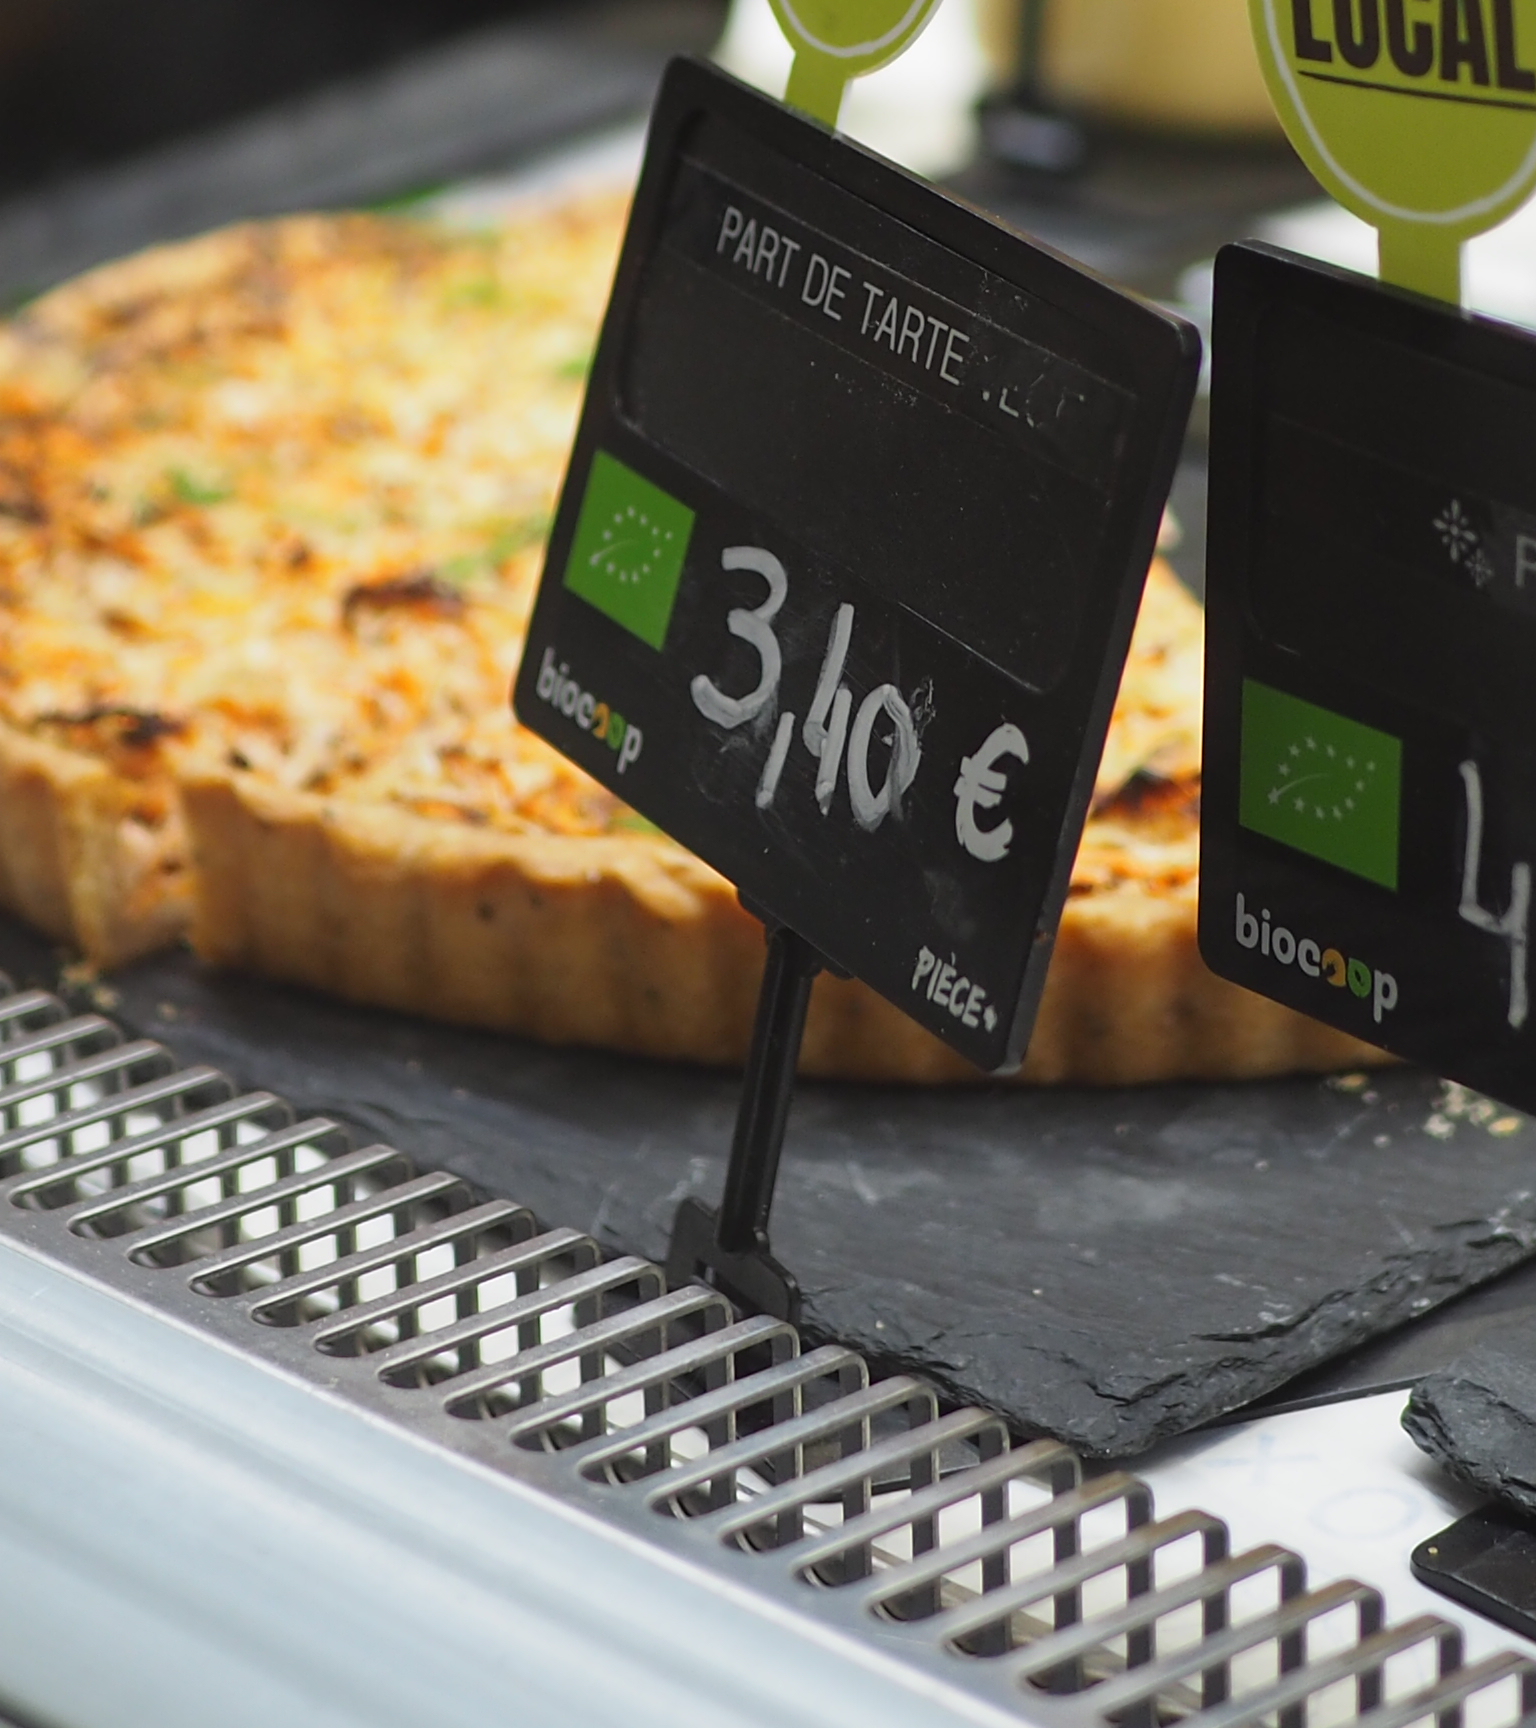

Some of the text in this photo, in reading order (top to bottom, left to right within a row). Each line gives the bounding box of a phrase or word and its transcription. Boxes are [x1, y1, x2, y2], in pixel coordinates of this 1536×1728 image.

[717, 206, 970, 386] PART DE TARTE
[535, 647, 643, 774] biocoop
[690, 545, 1030, 862] 3,40 €
[1234, 891, 1400, 1024] biocoop
